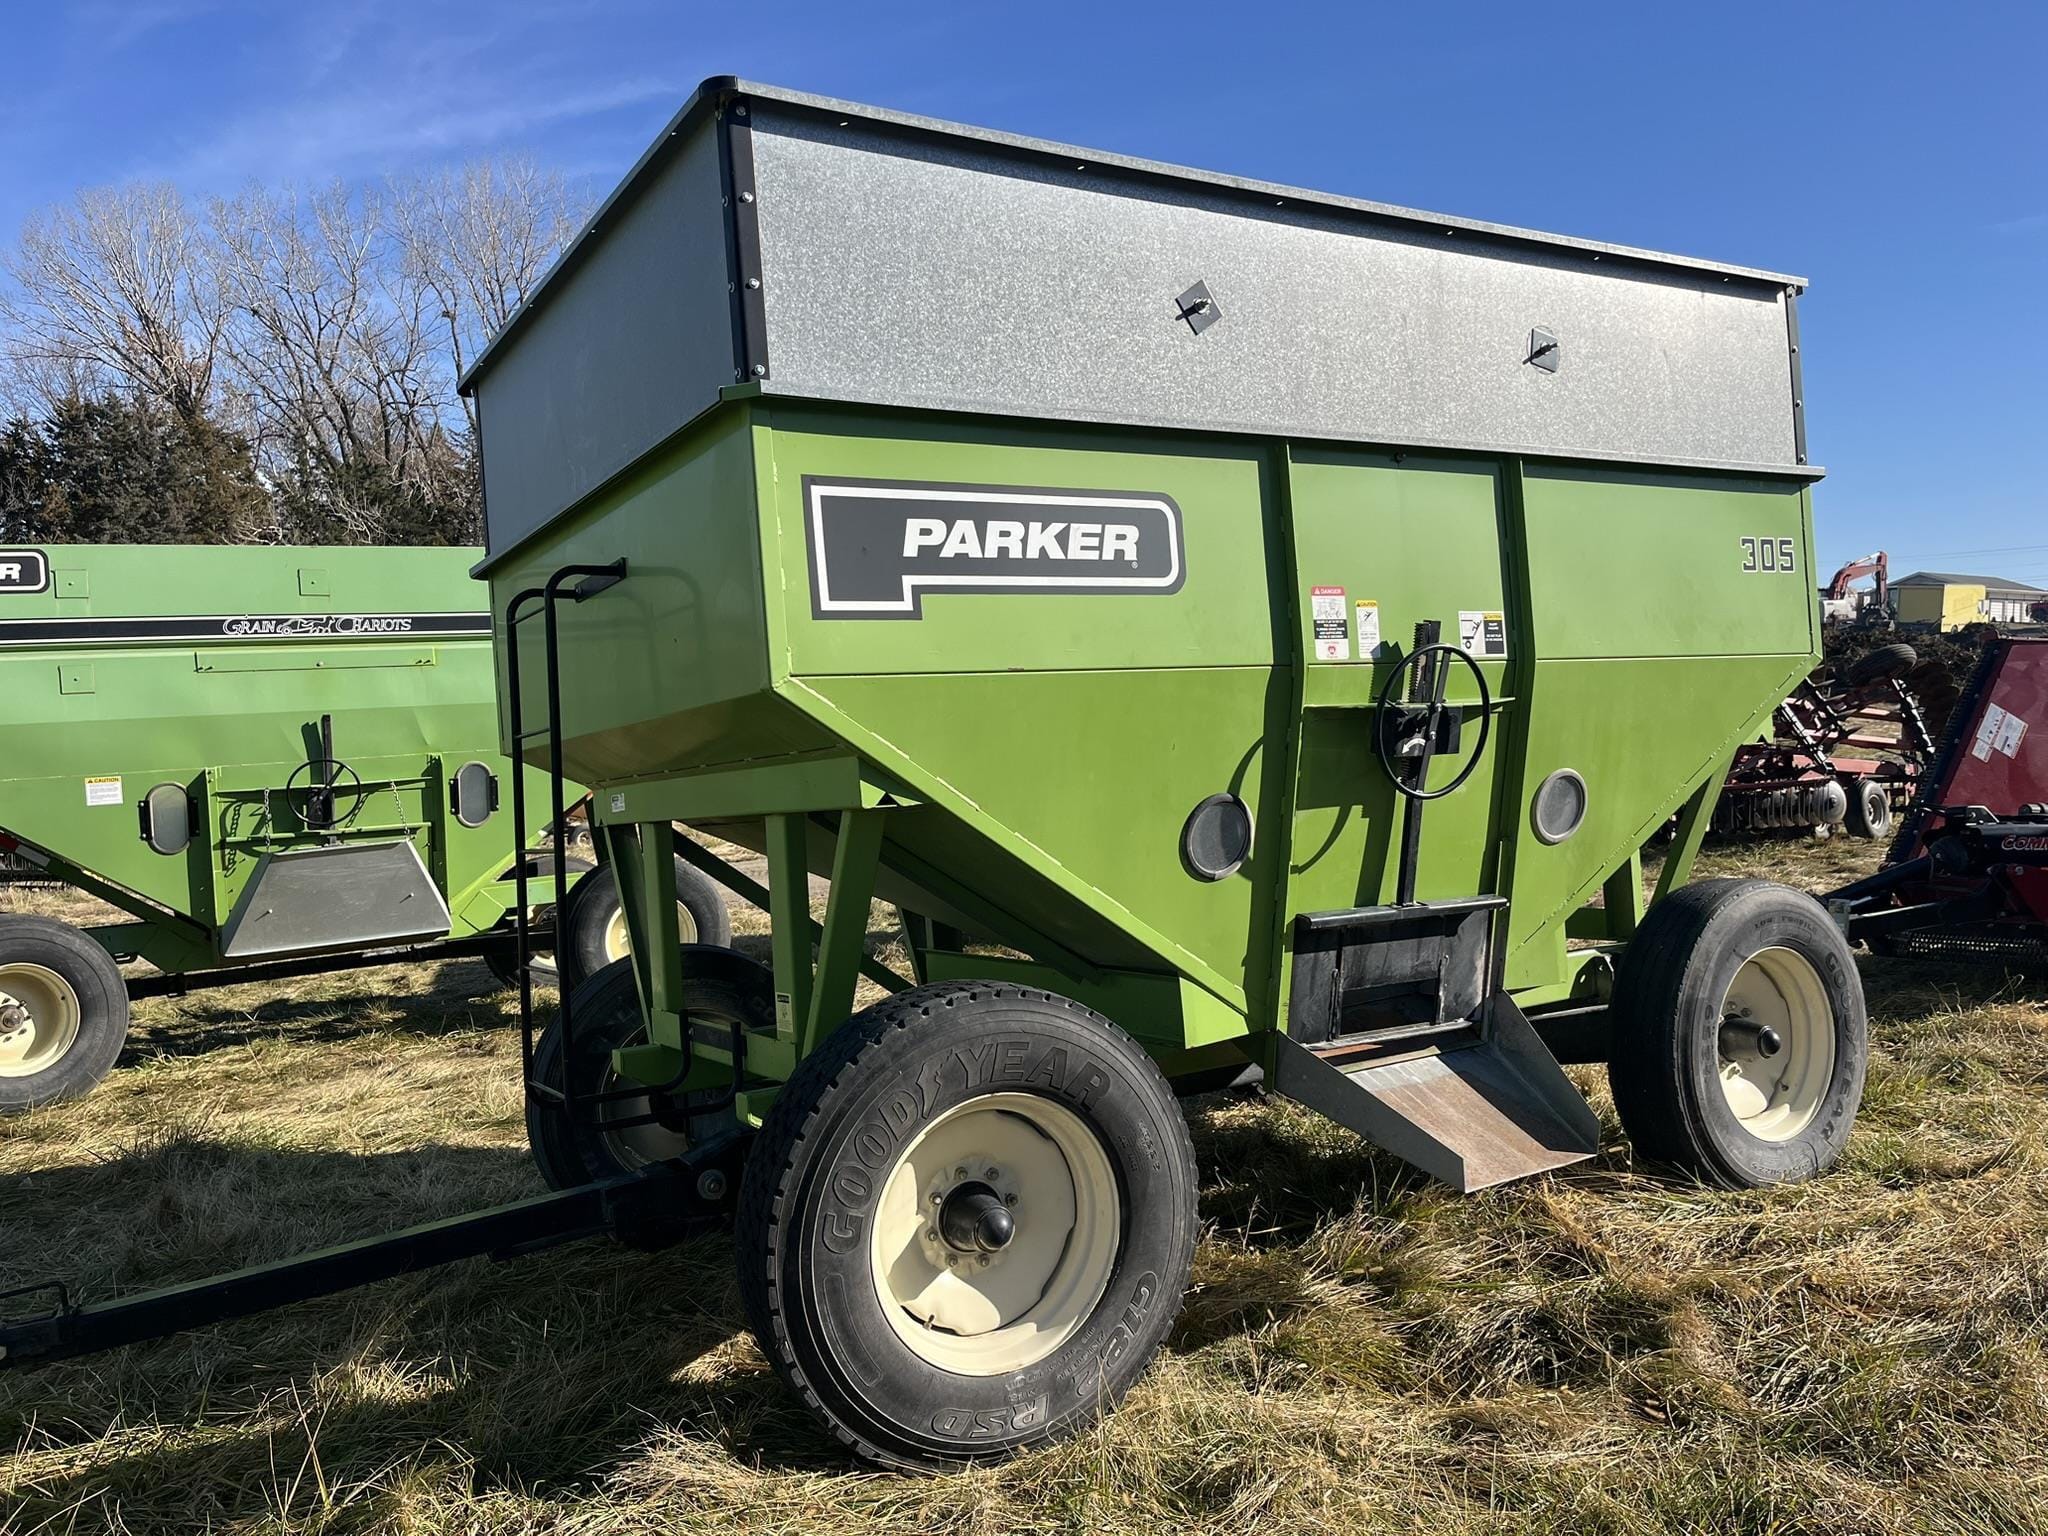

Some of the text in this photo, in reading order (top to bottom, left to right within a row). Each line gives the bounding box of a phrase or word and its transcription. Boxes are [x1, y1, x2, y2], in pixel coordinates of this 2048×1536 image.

[902, 517, 1140, 561] PARKER
[1740, 536, 1795, 573] 305
[222, 616, 412, 636] GRAIN CHARIOTS
[1820, 951, 1858, 1140] GOODYEAR
[822, 1041, 1112, 1254] GOODYEAR
[1072, 1270, 1159, 1398] G182
[931, 1393, 1050, 1438] RSD
